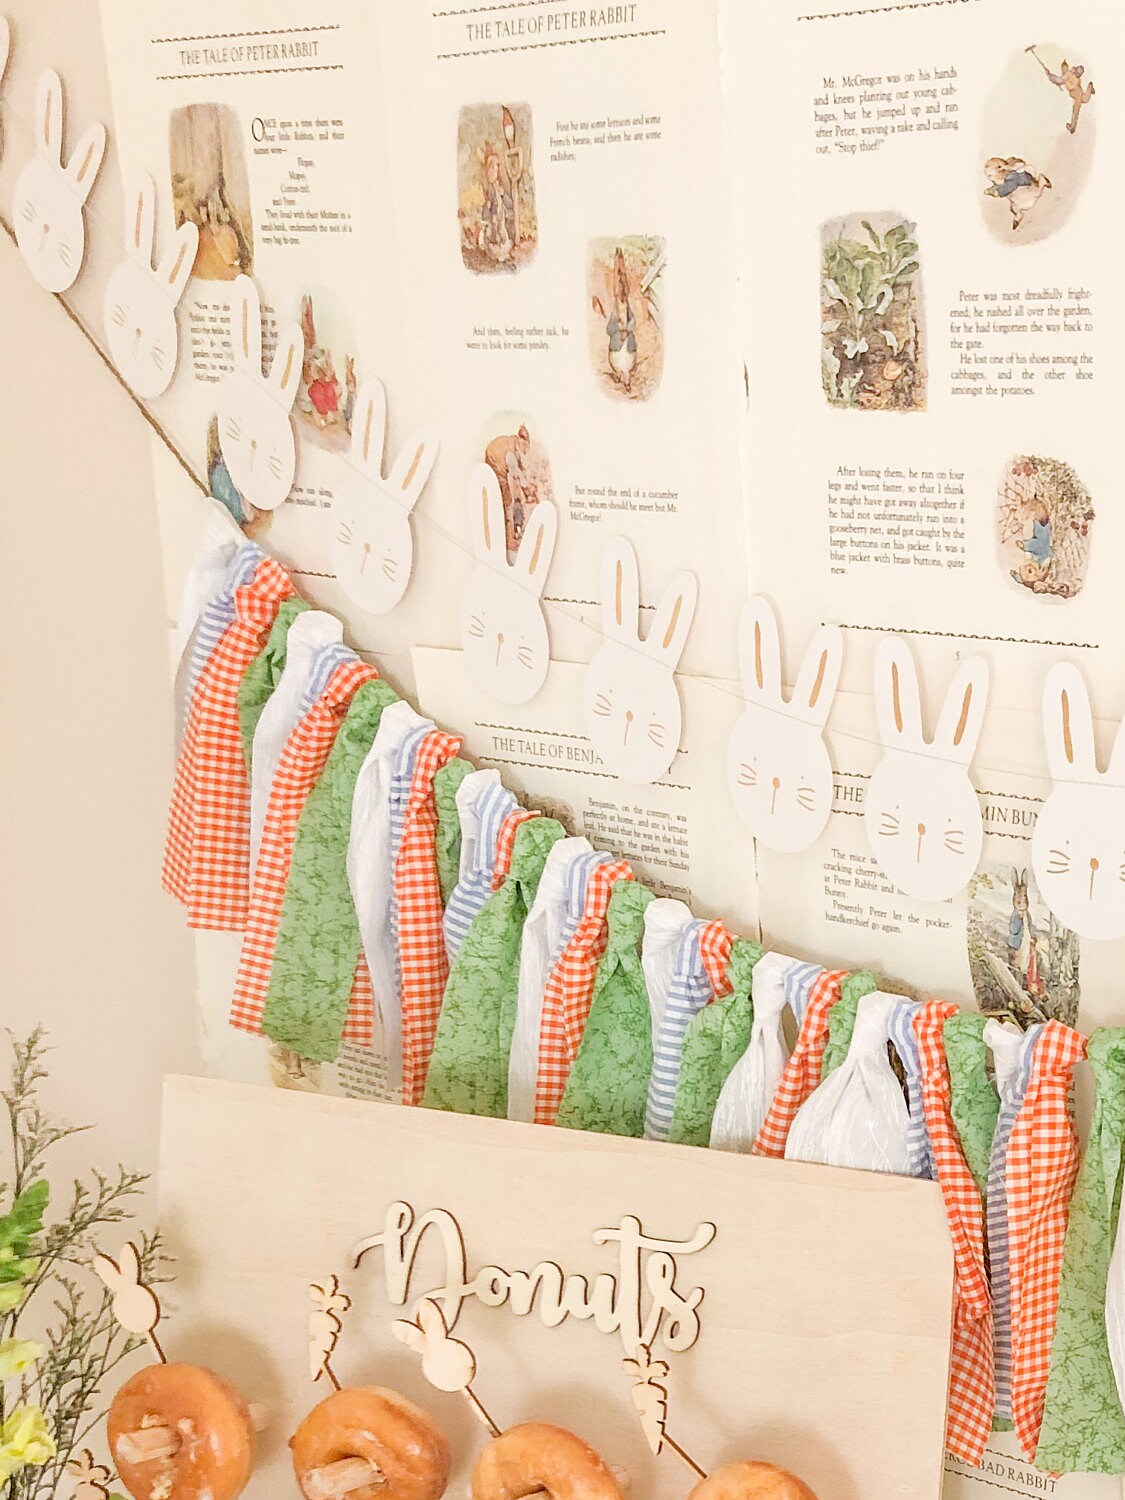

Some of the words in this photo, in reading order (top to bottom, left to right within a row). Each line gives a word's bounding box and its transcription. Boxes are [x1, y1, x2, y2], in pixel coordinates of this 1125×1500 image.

[465, 21, 492, 40] THE
[494, 17, 525, 37] TALE
[527, 15, 544, 33] OF
[547, 10, 586, 31] PETER
[589, 4, 637, 27] RABBIT
[178, 49, 200, 66] THE
[202, 47, 228, 64] TALE
[229, 46, 244, 62] OF
[246, 43, 279, 61] PETER
[280, 40, 319, 59] RABBIT
[822, 76, 837, 89] Mr.
[841, 73, 882, 88] McGregor
[885, 74, 900, 83] was
[904, 73, 915, 82] on
[918, 68, 931, 81] his
[933, 65, 958, 80] hands
[492, 735, 515, 753] THE
[517, 739, 546, 757] TALE
[548, 744, 565, 759] OF
[832, 783, 864, 803] THE
[352, 1200, 717, 1357] Donuts
[1007, 1468, 1059, 1493] RABBIT
